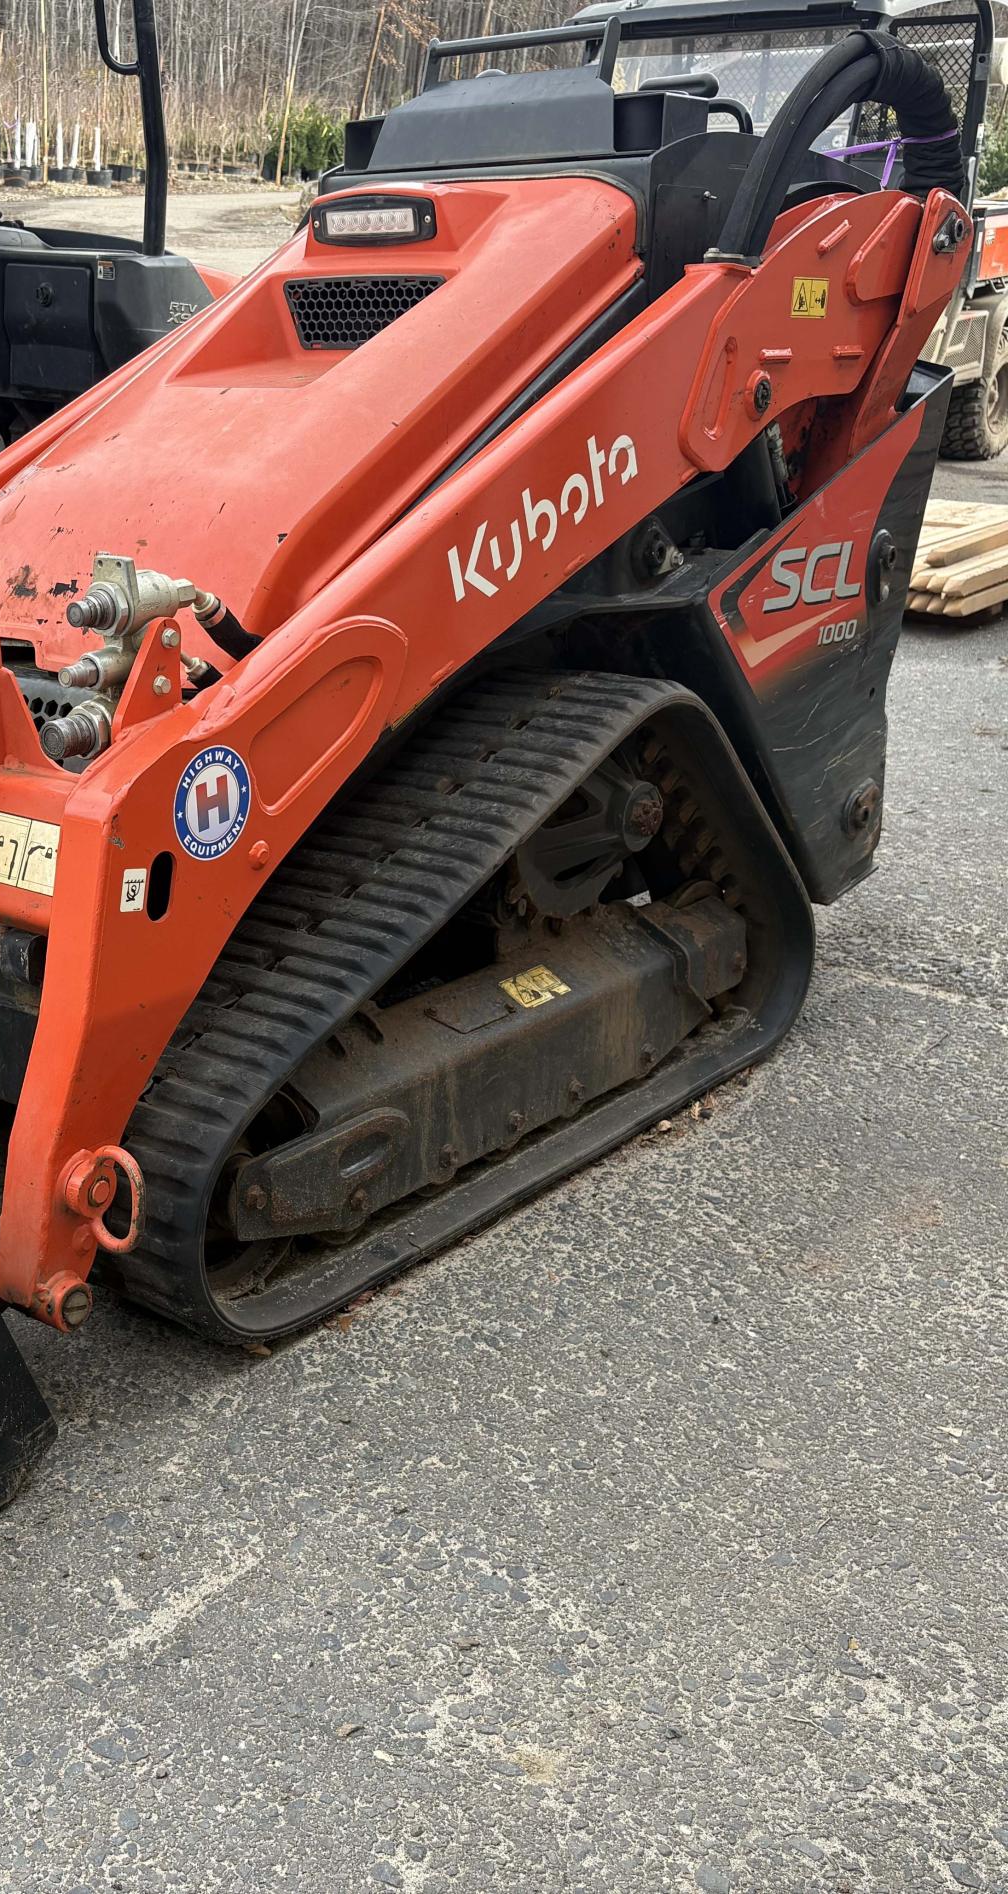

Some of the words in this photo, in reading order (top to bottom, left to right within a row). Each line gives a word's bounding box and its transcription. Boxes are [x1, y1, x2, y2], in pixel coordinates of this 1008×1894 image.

[169, 301, 198, 312] RTV
[447, 434, 639, 603] Kubota
[762, 540, 862, 615] SCL
[817, 619, 859, 648] 1000
[182, 750, 241, 789] HIGHWAY
[195, 773, 231, 834] H
[183, 812, 245, 857] EQUIPMENT
